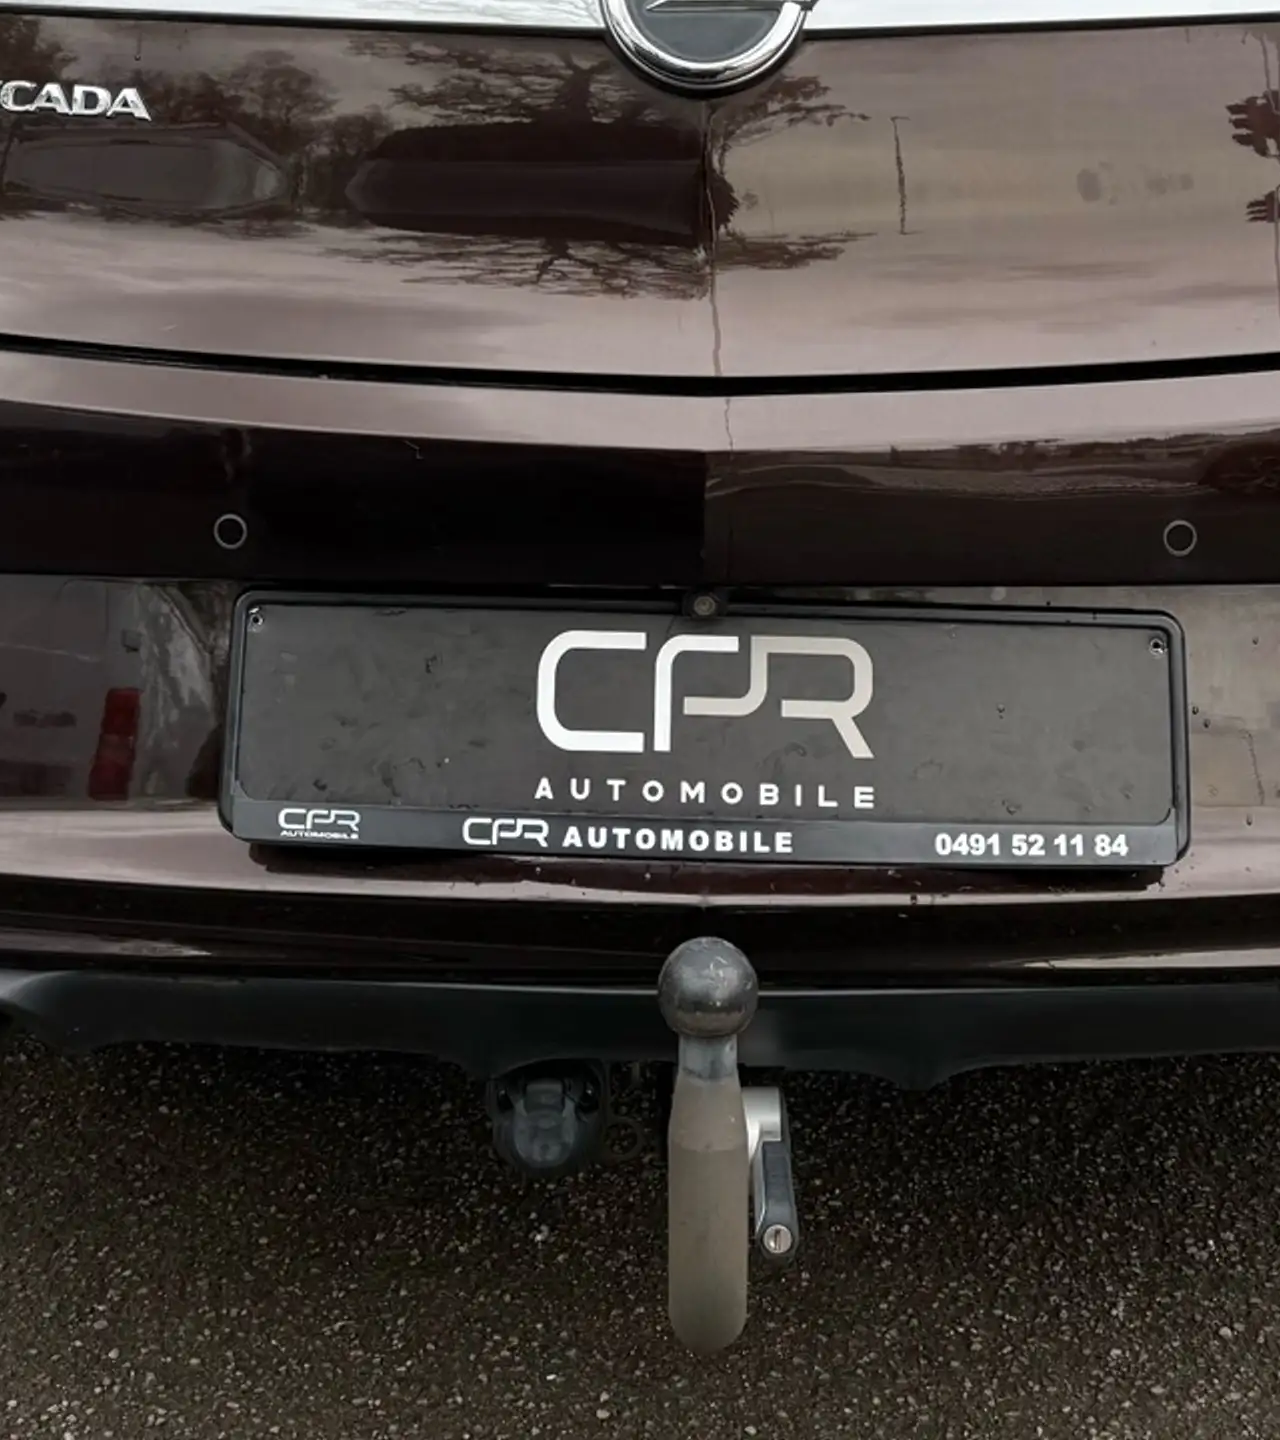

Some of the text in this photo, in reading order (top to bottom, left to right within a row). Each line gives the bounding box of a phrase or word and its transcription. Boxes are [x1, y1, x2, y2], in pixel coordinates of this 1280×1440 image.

[537, 630, 875, 759] CPR
[535, 777, 875, 809] AUTOMOBILE
[278, 808, 361, 831] CPR
[462, 817, 793, 853] CPR AUTOMOBILE
[935, 833, 1129, 857] 0491 52 11 84
